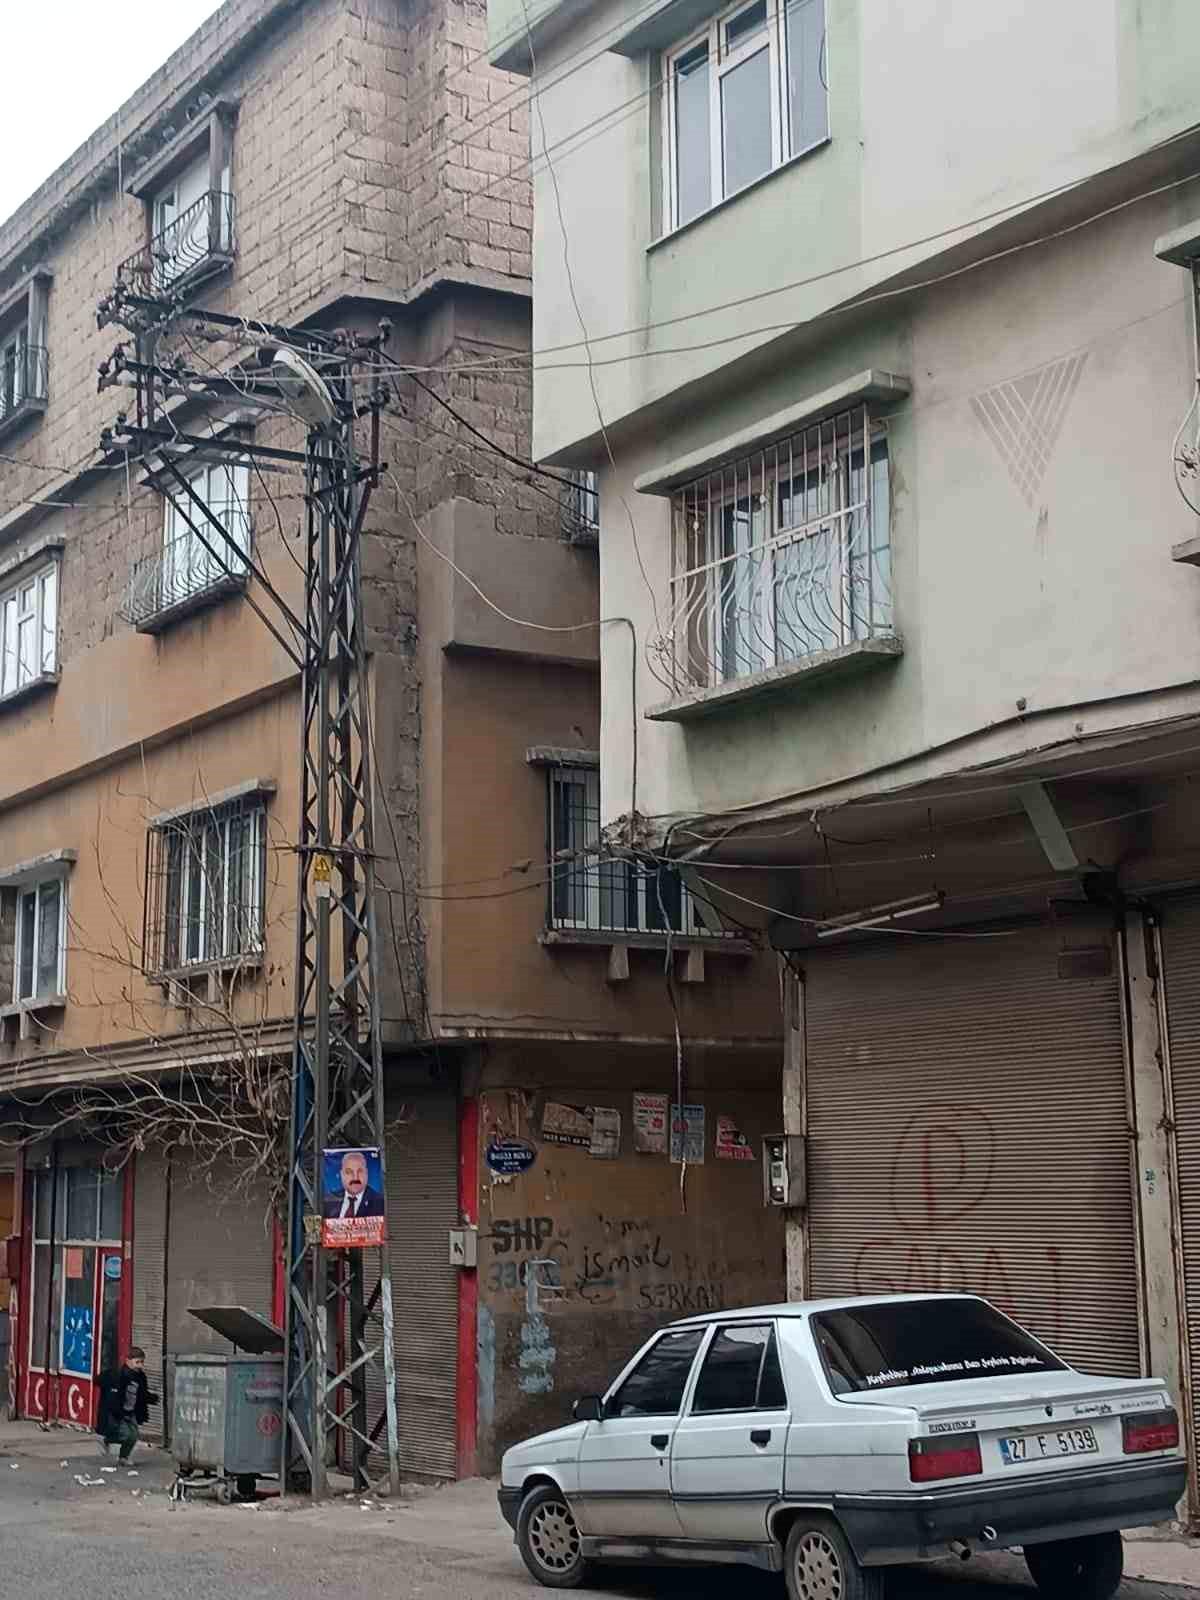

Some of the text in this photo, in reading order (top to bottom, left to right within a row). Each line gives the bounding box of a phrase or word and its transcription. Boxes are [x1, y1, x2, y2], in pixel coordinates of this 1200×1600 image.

[493, 1217, 553, 1255] SHP
[1008, 1430, 1095, 1459] 27 F 5139
